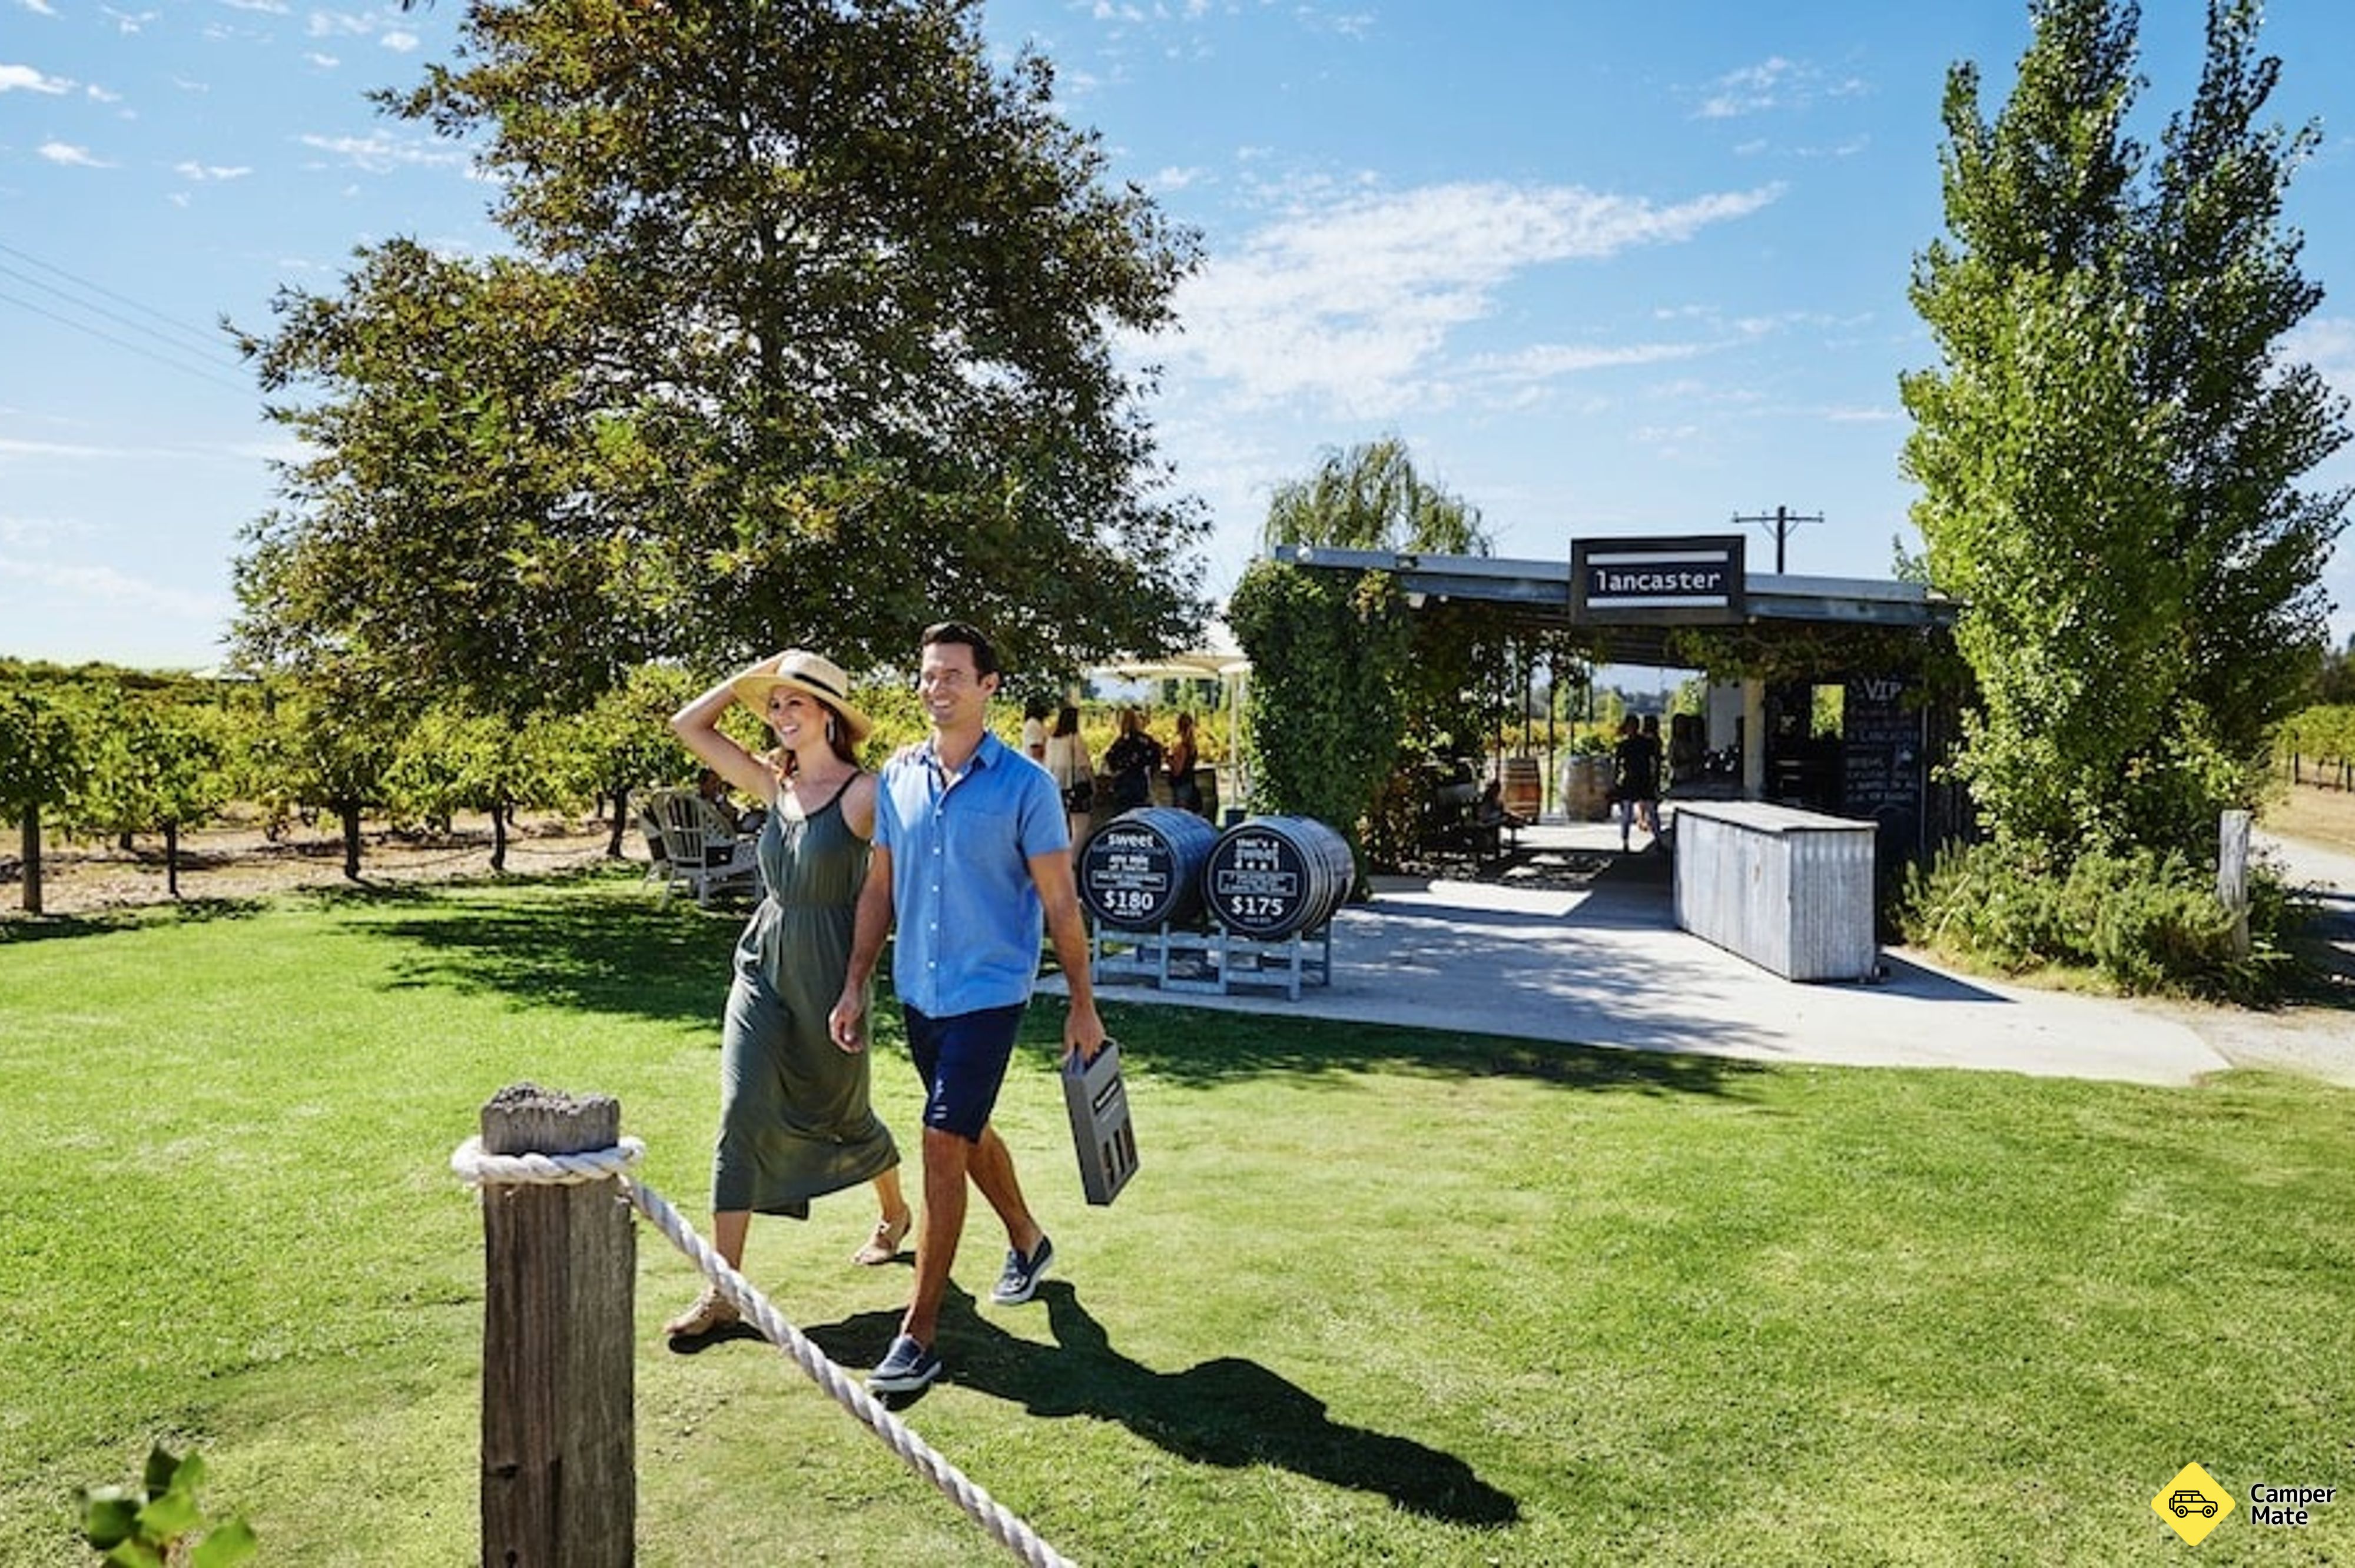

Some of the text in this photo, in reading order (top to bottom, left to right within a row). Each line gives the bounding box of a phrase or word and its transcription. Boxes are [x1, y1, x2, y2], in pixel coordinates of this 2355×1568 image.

[1595, 570, 1721, 591] lancaster
[1107, 833, 1154, 847] sweet
[1103, 890, 1154, 911] $180
[1231, 895, 1283, 916] $175
